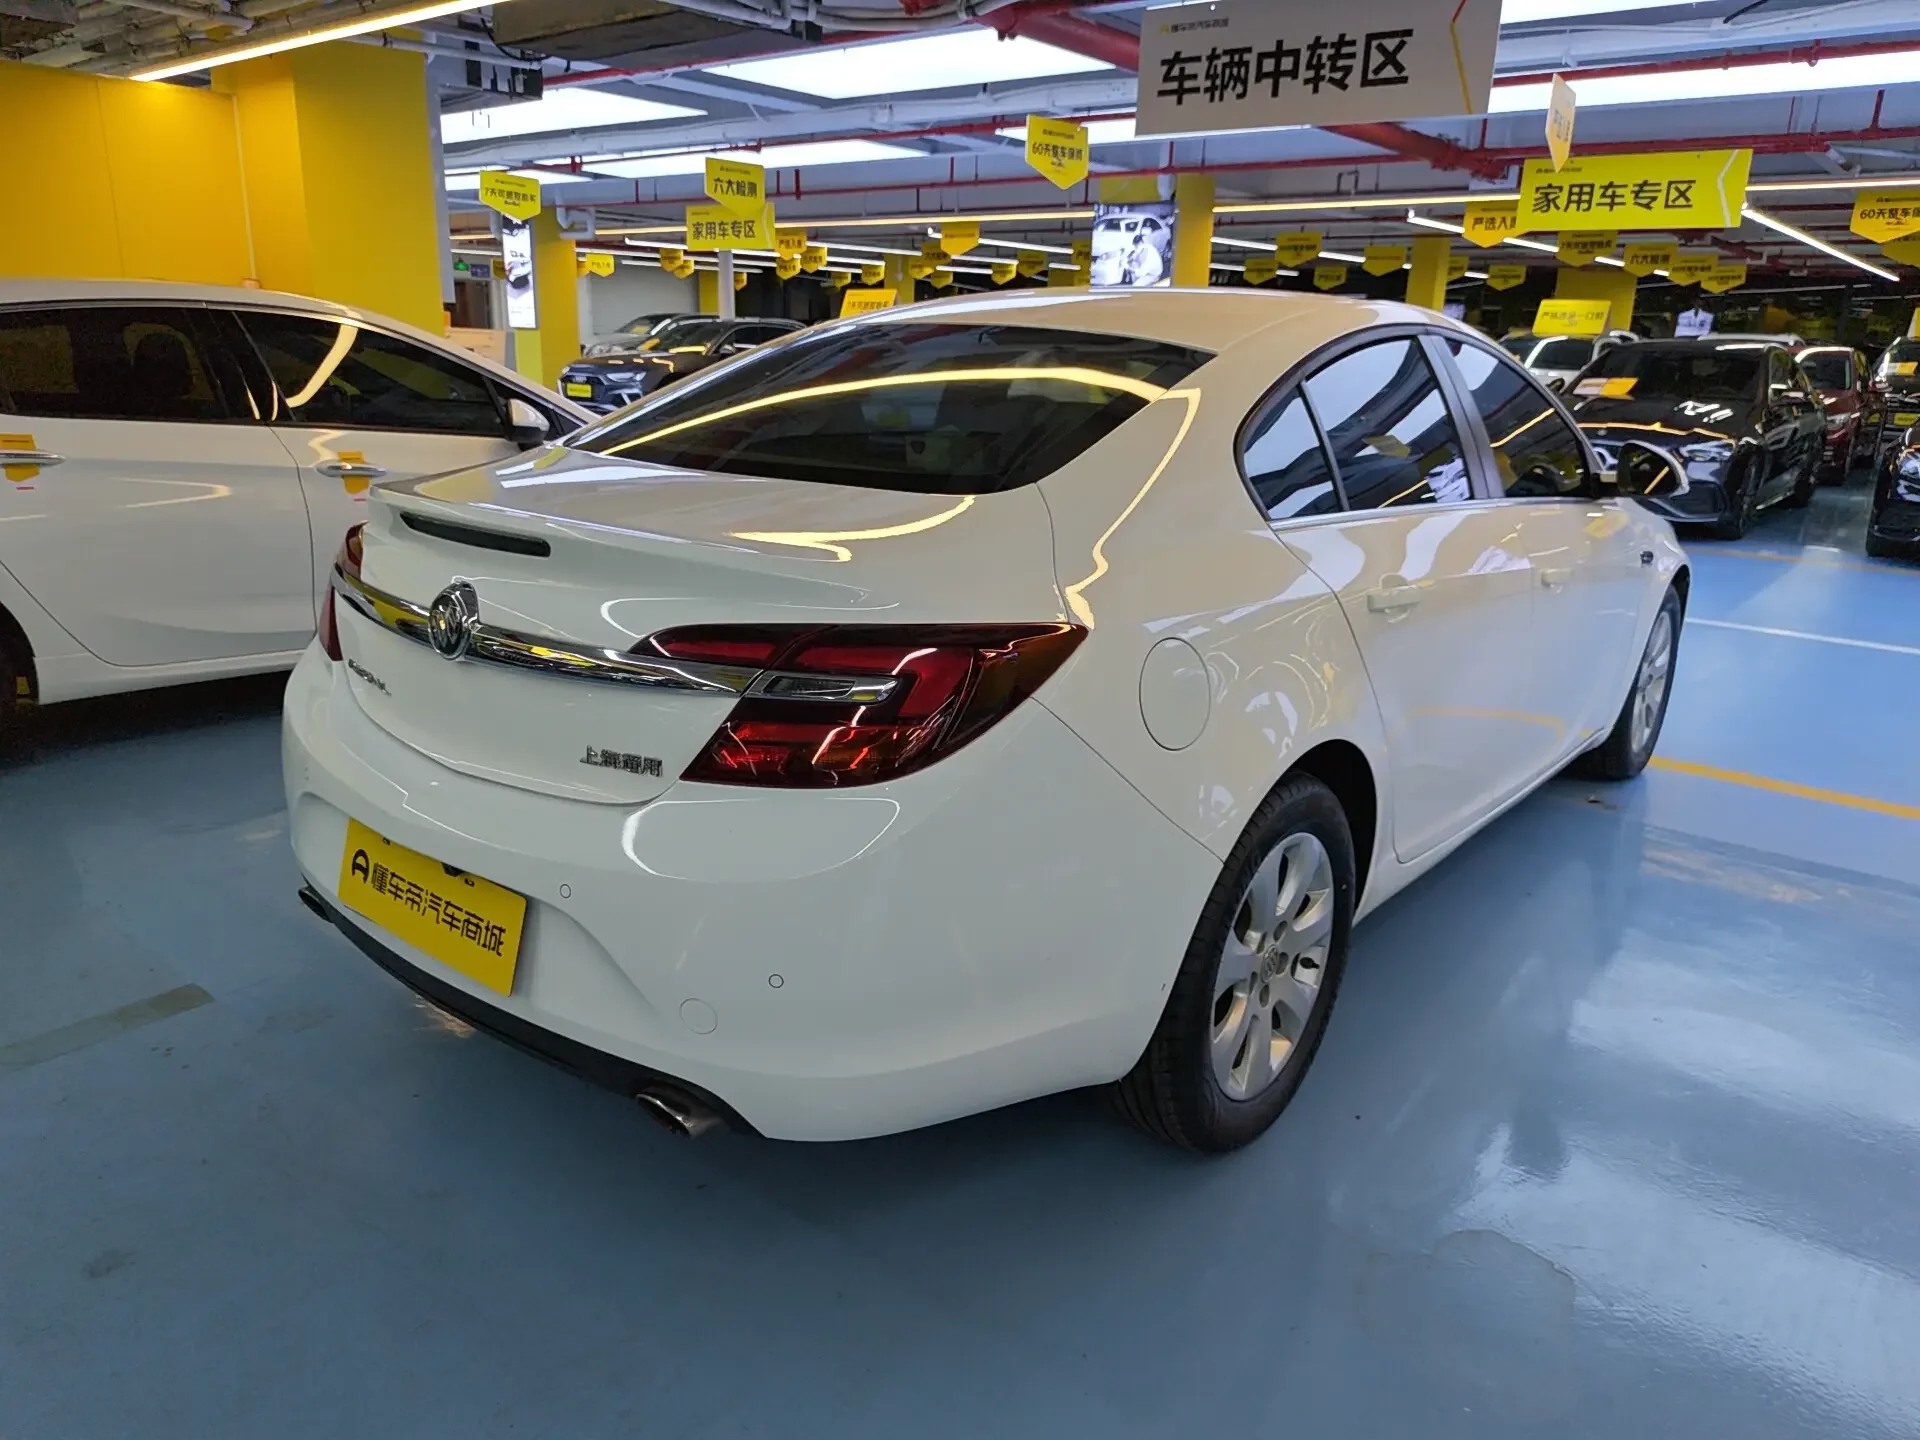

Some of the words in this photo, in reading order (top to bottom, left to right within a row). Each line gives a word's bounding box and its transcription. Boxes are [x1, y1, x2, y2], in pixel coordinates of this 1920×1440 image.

[1157, 29, 1414, 106] 车辆中转区
[713, 177, 757, 199] 六大检测
[1531, 179, 1697, 214] 家用车专区
[692, 220, 755, 240] 家用车专区
